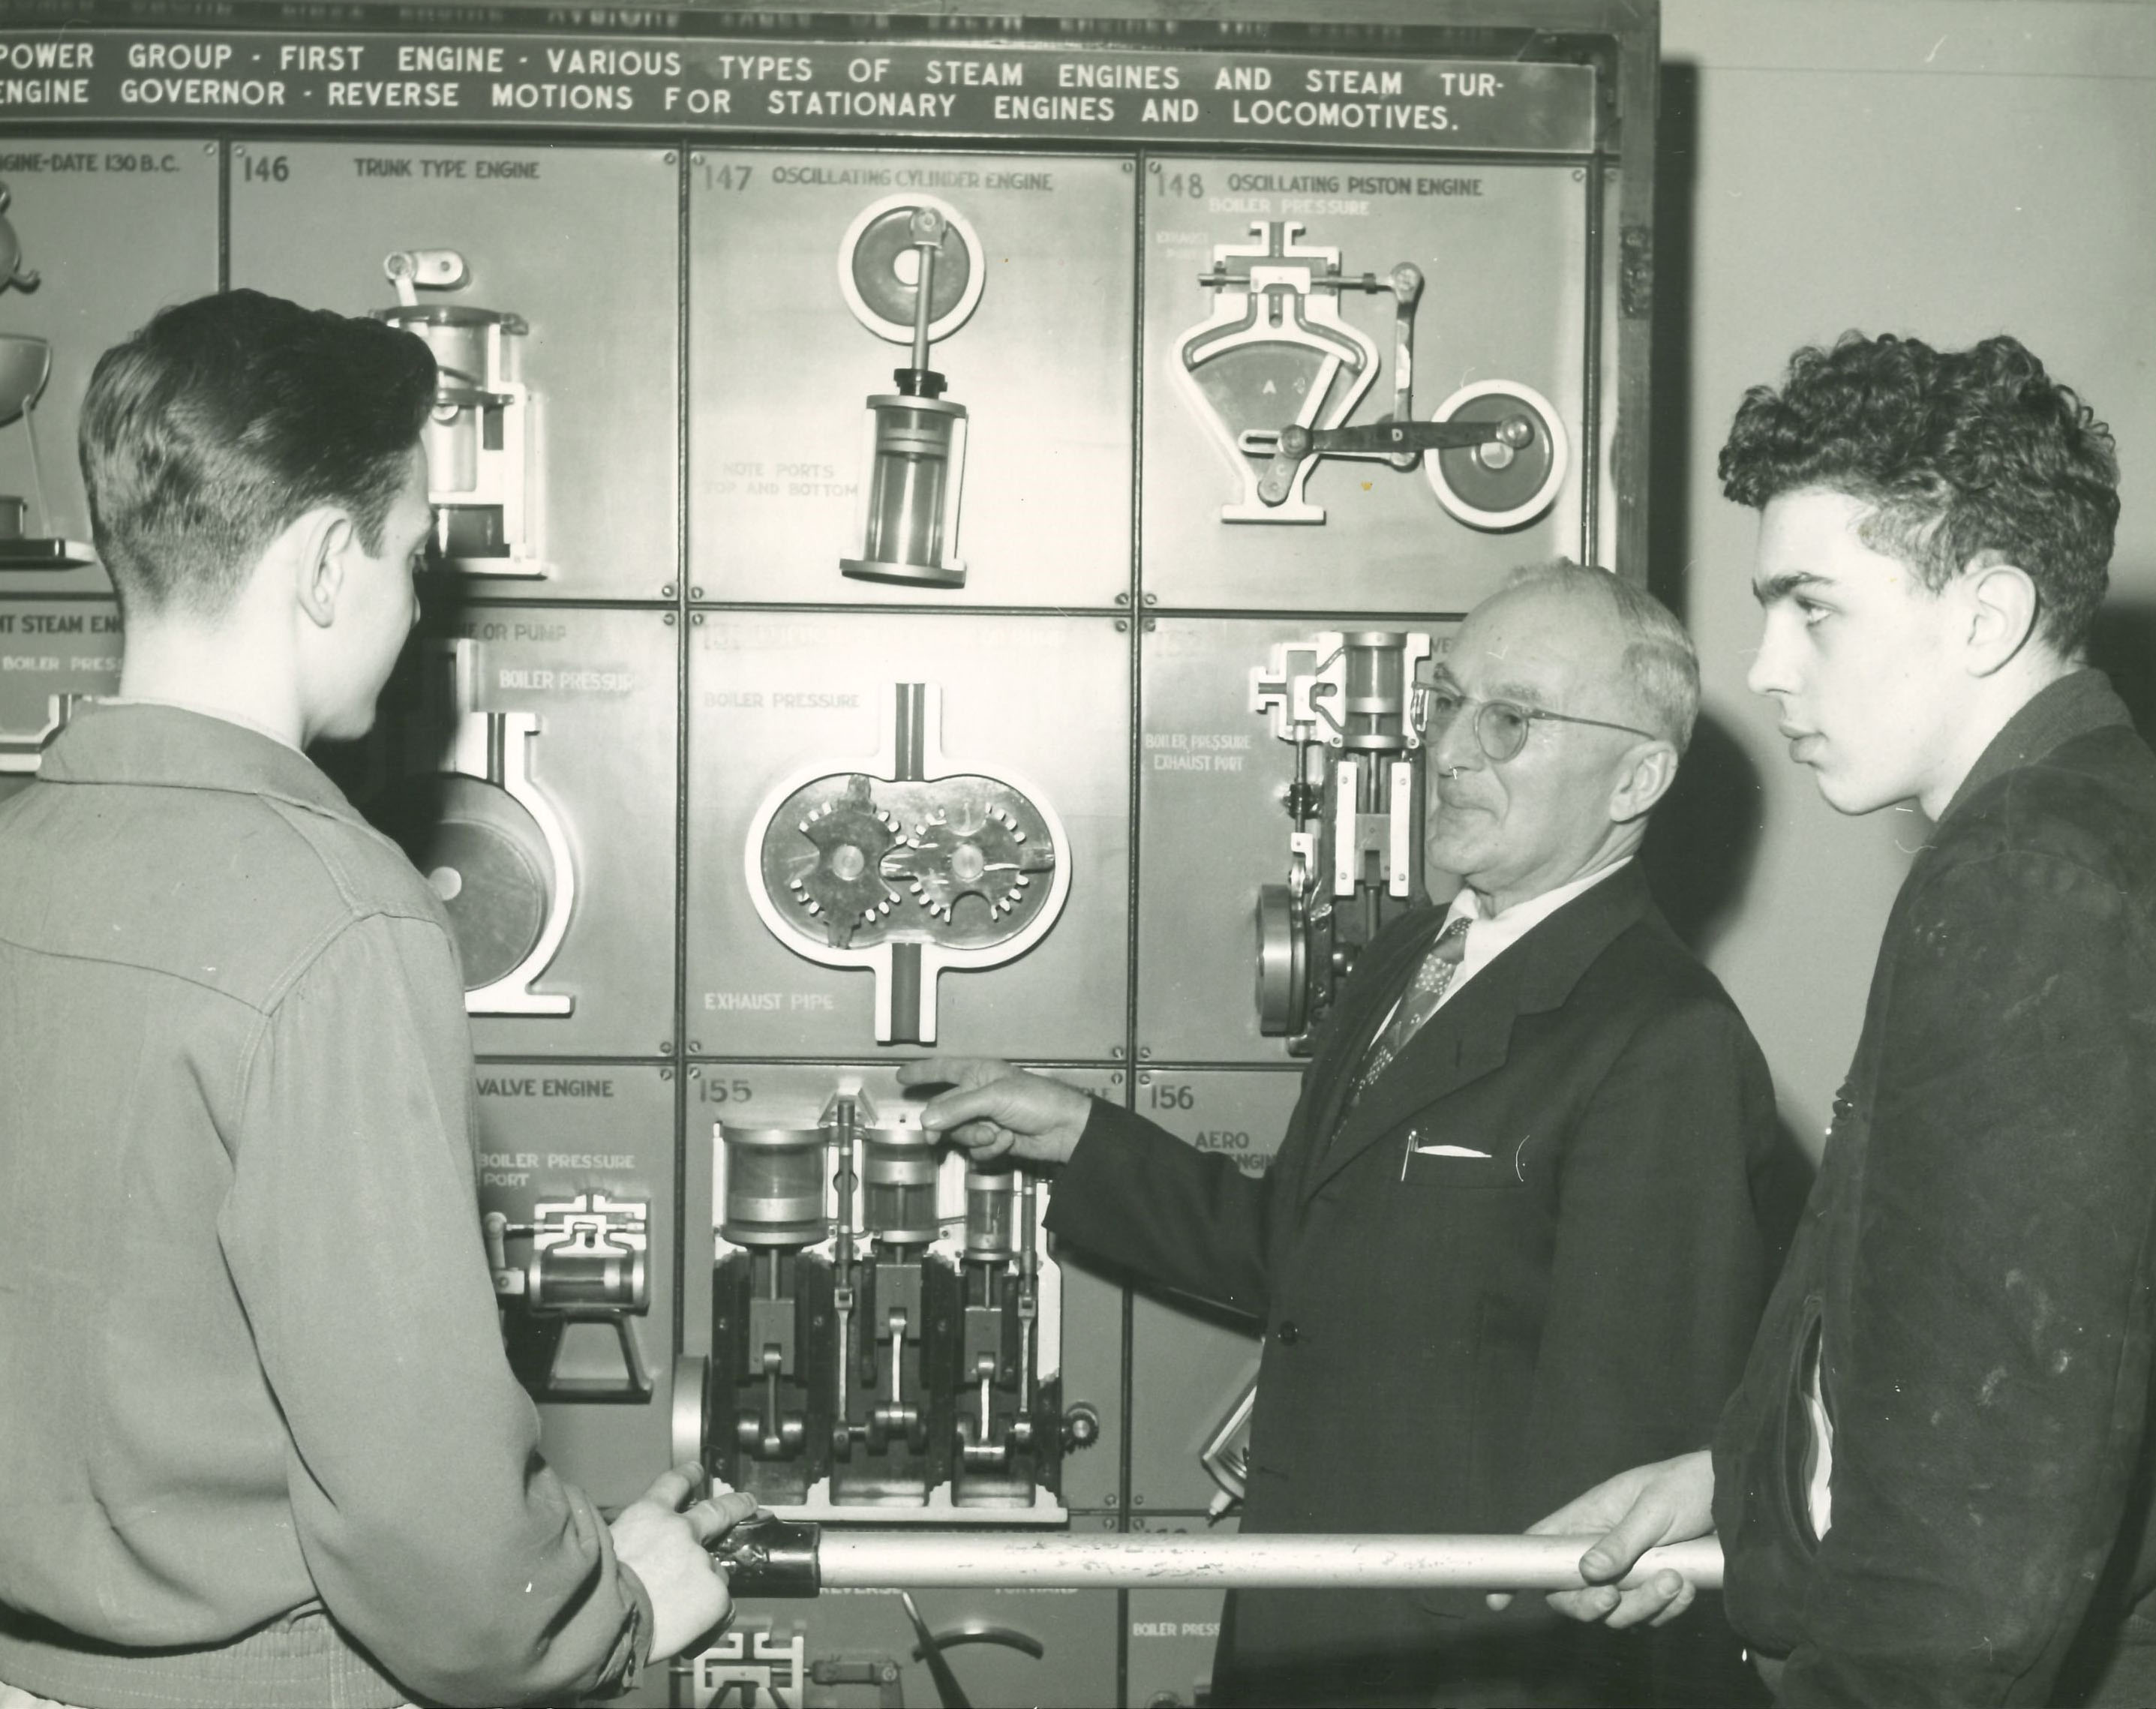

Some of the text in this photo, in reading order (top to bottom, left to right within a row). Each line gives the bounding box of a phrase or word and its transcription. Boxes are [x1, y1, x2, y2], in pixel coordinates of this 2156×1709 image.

[0, 43, 94, 69] POWER
[128, 44, 232, 69] GROUP
[281, 45, 364, 71] FIRST
[398, 47, 503, 72] ENGINE
[547, 49, 680, 75] VARIOUS
[719, 56, 812, 81] TYPES
[848, 59, 890, 83] OF
[926, 60, 1022, 86] STEAM
[1058, 64, 1179, 89] ENGINES
[1215, 68, 1272, 90] AND
[1305, 69, 1401, 95] STEAM
[1441, 73, 1503, 96] TUR-
[121, 80, 284, 105] GOVERNOR
[329, 83, 458, 107] REVERSE
[492, 83, 633, 110] MOTIONS
[665, 87, 731, 113] FOR
[767, 90, 956, 117] STATIONARY
[994, 95, 1115, 122] ENGINES
[1142, 99, 1198, 122] AND
[1233, 100, 1458, 131] LOCOMOTIVES.
[106, 155, 137, 172] 130
[141, 155, 180, 172] B.C.
[244, 155, 289, 182] 146
[354, 158, 539, 179] TRUNK TYPE ENGINE
[706, 164, 752, 191] 147
[772, 166, 1052, 191] OSCILLATING CYLINDER ENGINE
[1158, 173, 1204, 198] 148
[1227, 174, 1482, 197] OSCILLATING PISTON ENGINE
[1209, 197, 1371, 215] BOILER PRESSURE
[723, 461, 834, 479] NOTE PORTS
[788, 482, 859, 498] BOTTOM
[21, 615, 83, 634] STEAM
[483, 623, 508, 641] OR
[499, 669, 553, 689] BOILER
[773, 691, 860, 709] PRESSURE
[1146, 733, 1252, 750] BOILER PRESSURE
[1154, 754, 1212, 771] EXHAUST
[703, 993, 835, 1011] EXHAUST PIPE
[476, 1078, 614, 1098] VALVE ENGINE
[700, 1079, 752, 1104] 155
[1152, 1086, 1194, 1110] 156
[1195, 1131, 1250, 1149] AERO
[547, 1154, 635, 1170] PRESSURE
[485, 1173, 530, 1187] PORT
